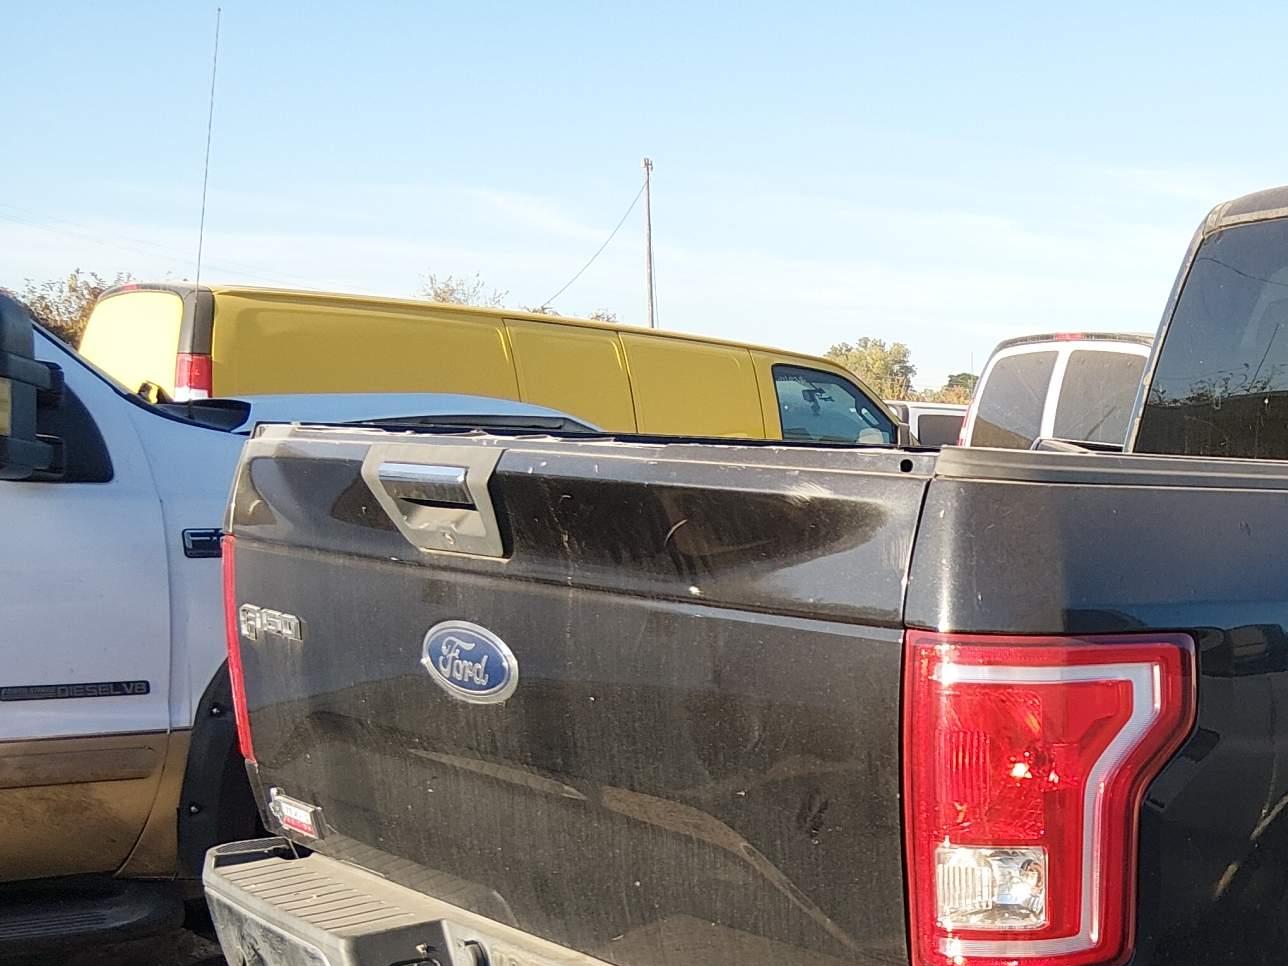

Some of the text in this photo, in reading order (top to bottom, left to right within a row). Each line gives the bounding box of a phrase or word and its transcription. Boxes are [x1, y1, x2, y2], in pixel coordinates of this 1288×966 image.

[439, 635, 489, 686] Ford
[57, 684, 121, 698] DIESEL
[122, 682, 147, 695] V8
